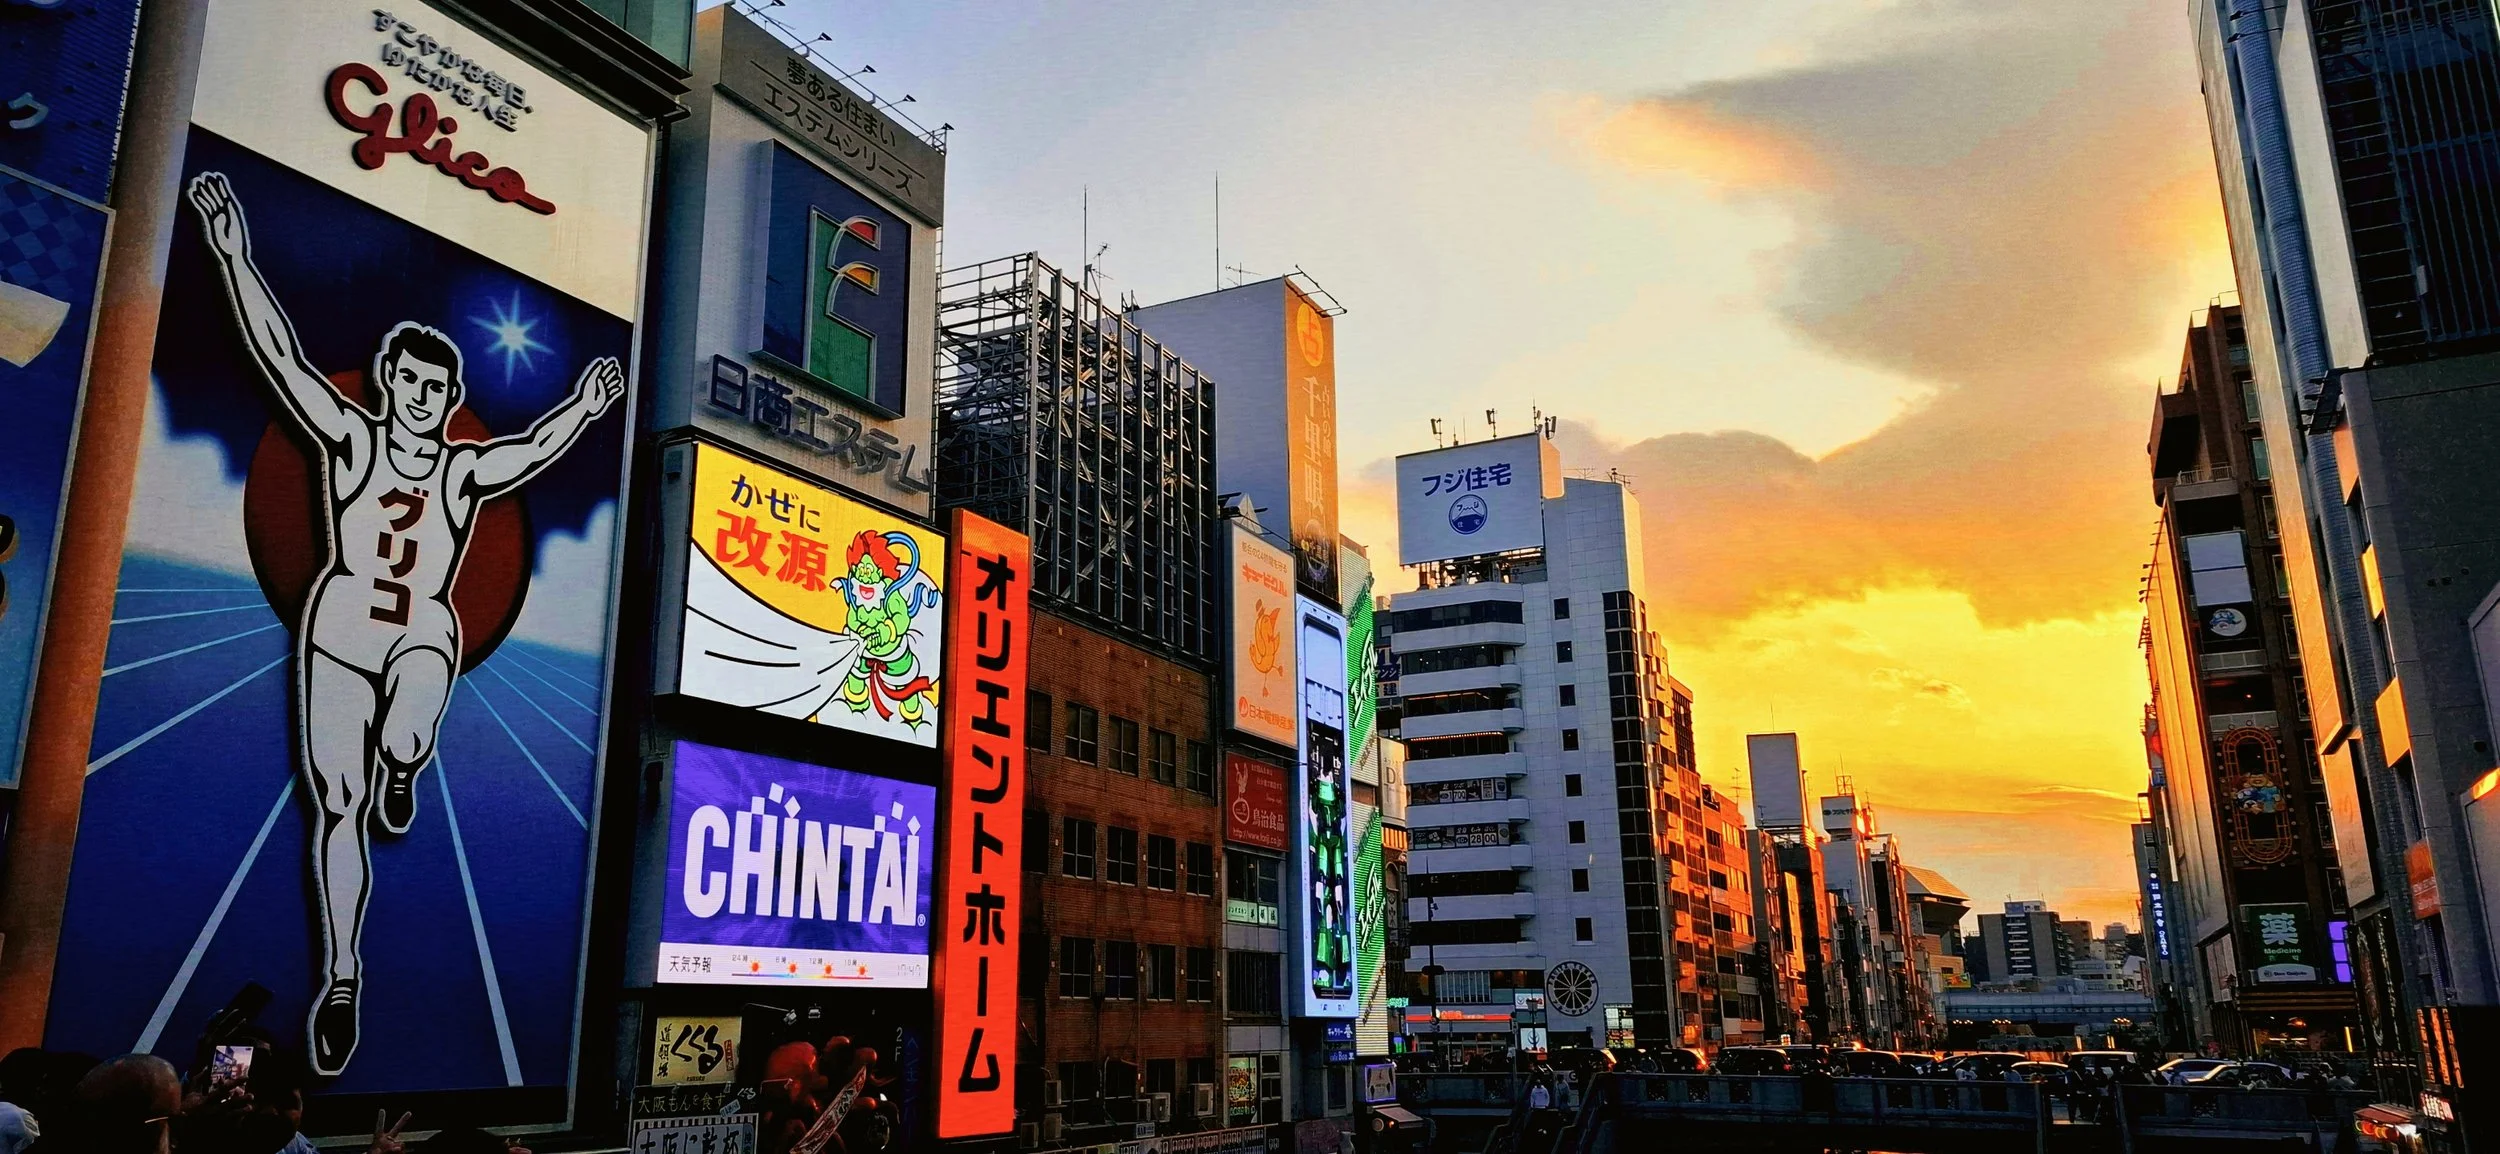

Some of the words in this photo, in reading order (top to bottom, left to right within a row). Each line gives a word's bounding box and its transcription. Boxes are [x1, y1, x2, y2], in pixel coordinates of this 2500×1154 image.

[371, 8, 535, 113] すこやかな毎日、
[381, 42, 518, 133] ゆたかな人生
[785, 57, 897, 148] 夢ある住まい
[324, 62, 557, 216] Glico
[763, 82, 914, 197] エステムシリーズ
[709, 352, 931, 492] 日商エステム
[730, 473, 821, 533] かぜに
[1422, 463, 1512, 497] フジ住宅
[369, 486, 430, 627] グリコ
[714, 508, 830, 593] 改源
[683, 782, 920, 927] CHINTAI
[958, 553, 1018, 1094] オリエントホーム
[669, 955, 712, 974] 天気予報
[2259, 913, 2298, 945] 薬
[670, 1024, 724, 1075] くくる
[895, 1027, 903, 1062] 2F
